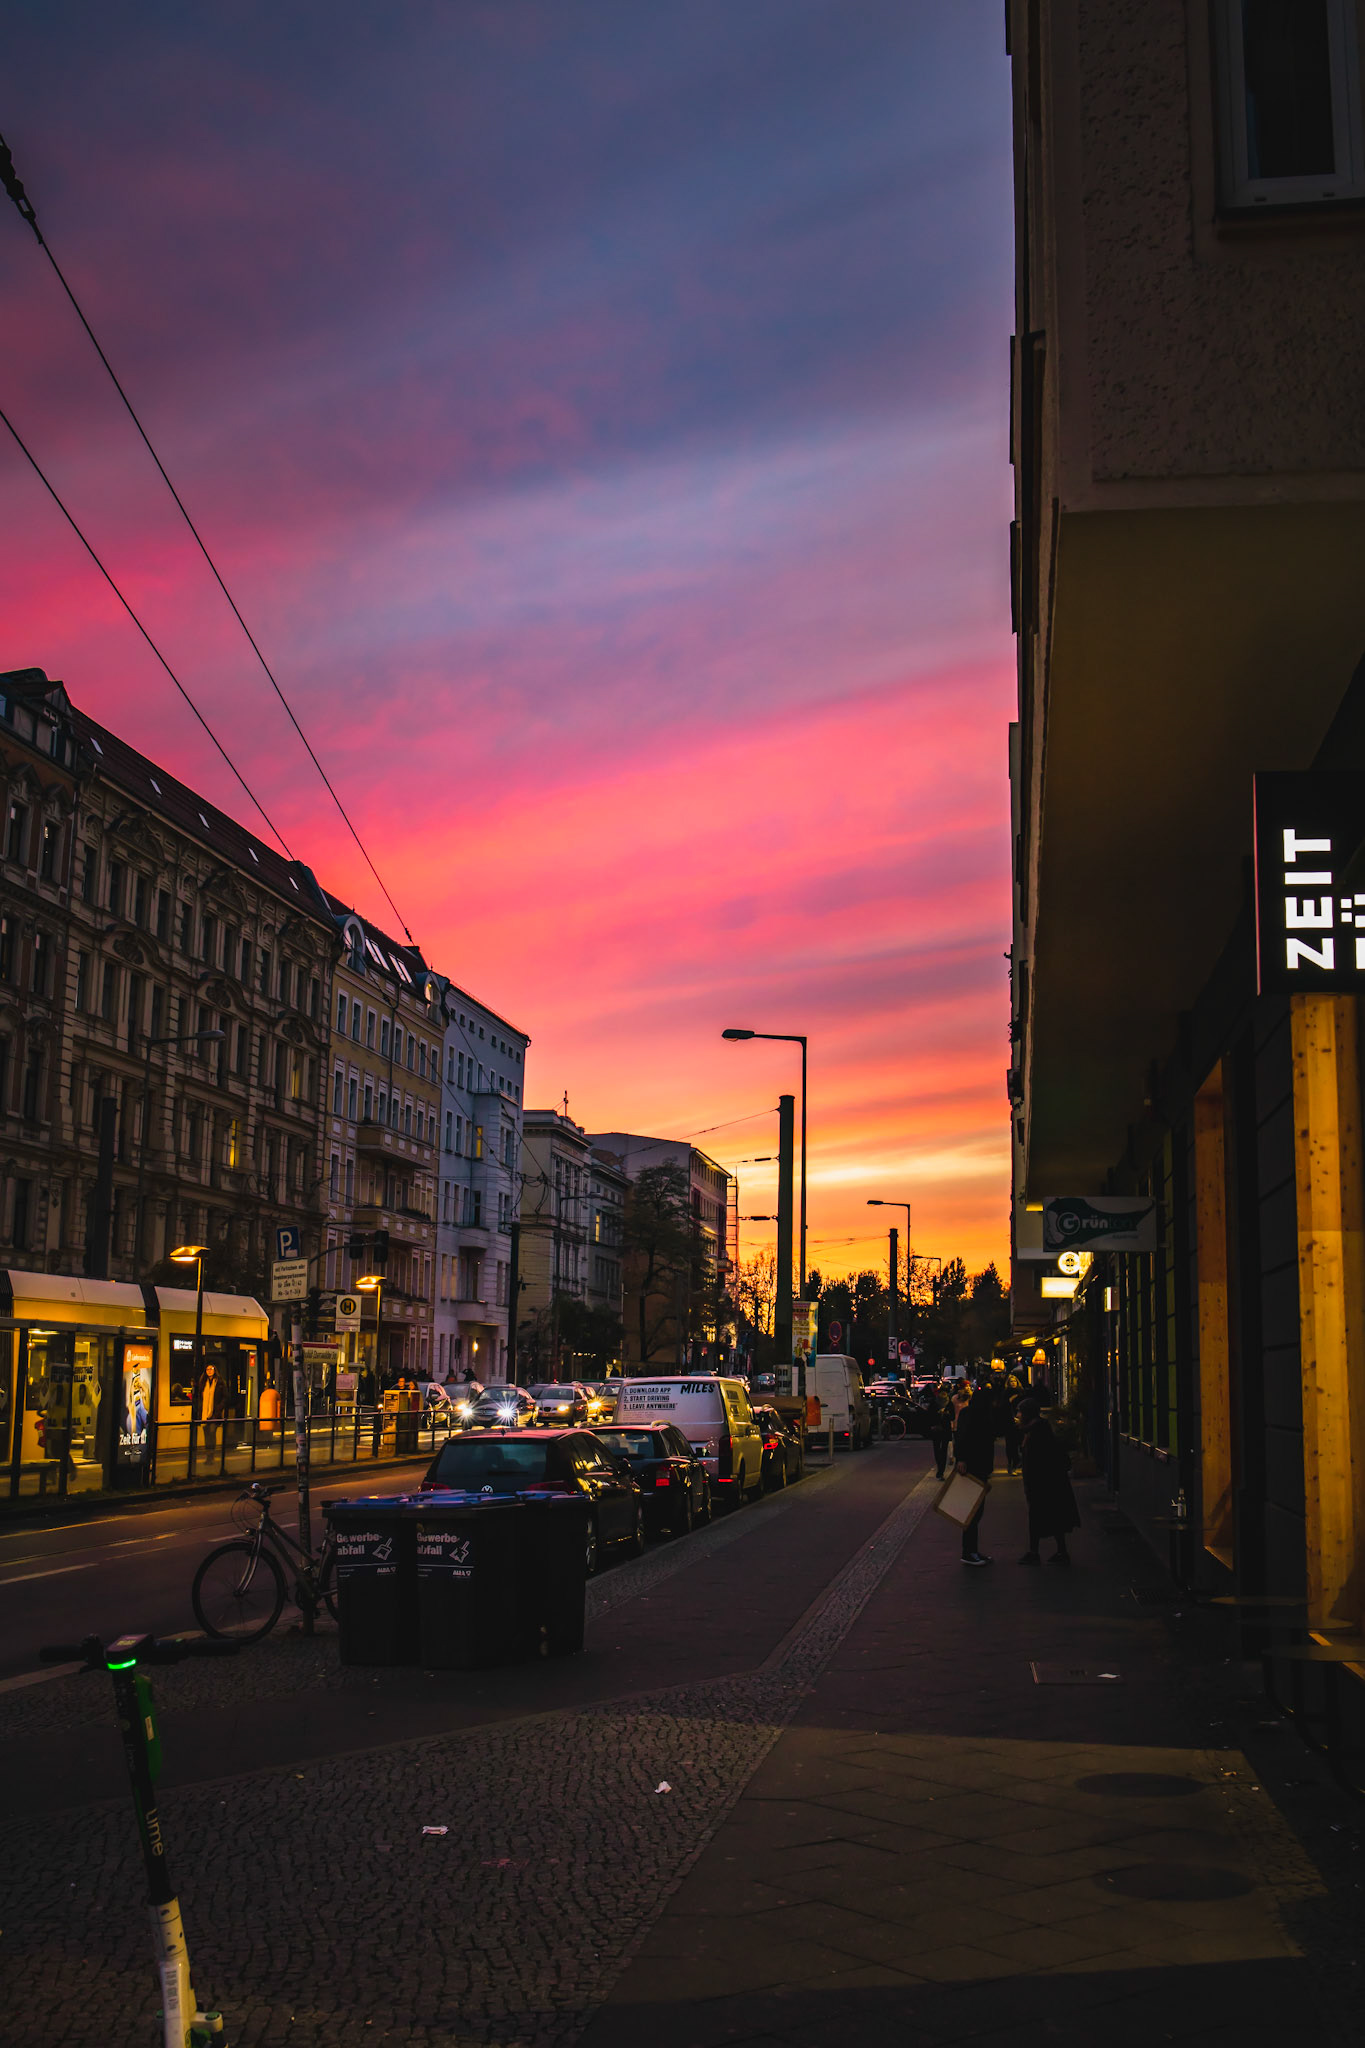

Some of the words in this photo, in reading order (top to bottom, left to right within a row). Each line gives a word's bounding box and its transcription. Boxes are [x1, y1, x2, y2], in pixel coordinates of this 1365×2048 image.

[1283, 828, 1335, 970] ZEIT
[280, 1231, 292, 1256] P
[680, 1383, 715, 1394] MILES
[119, 1433, 131, 1446] Zeit
[131, 1432, 140, 1445] für
[337, 1544, 365, 1556] abfall
[146, 1808, 163, 1856] Lime
